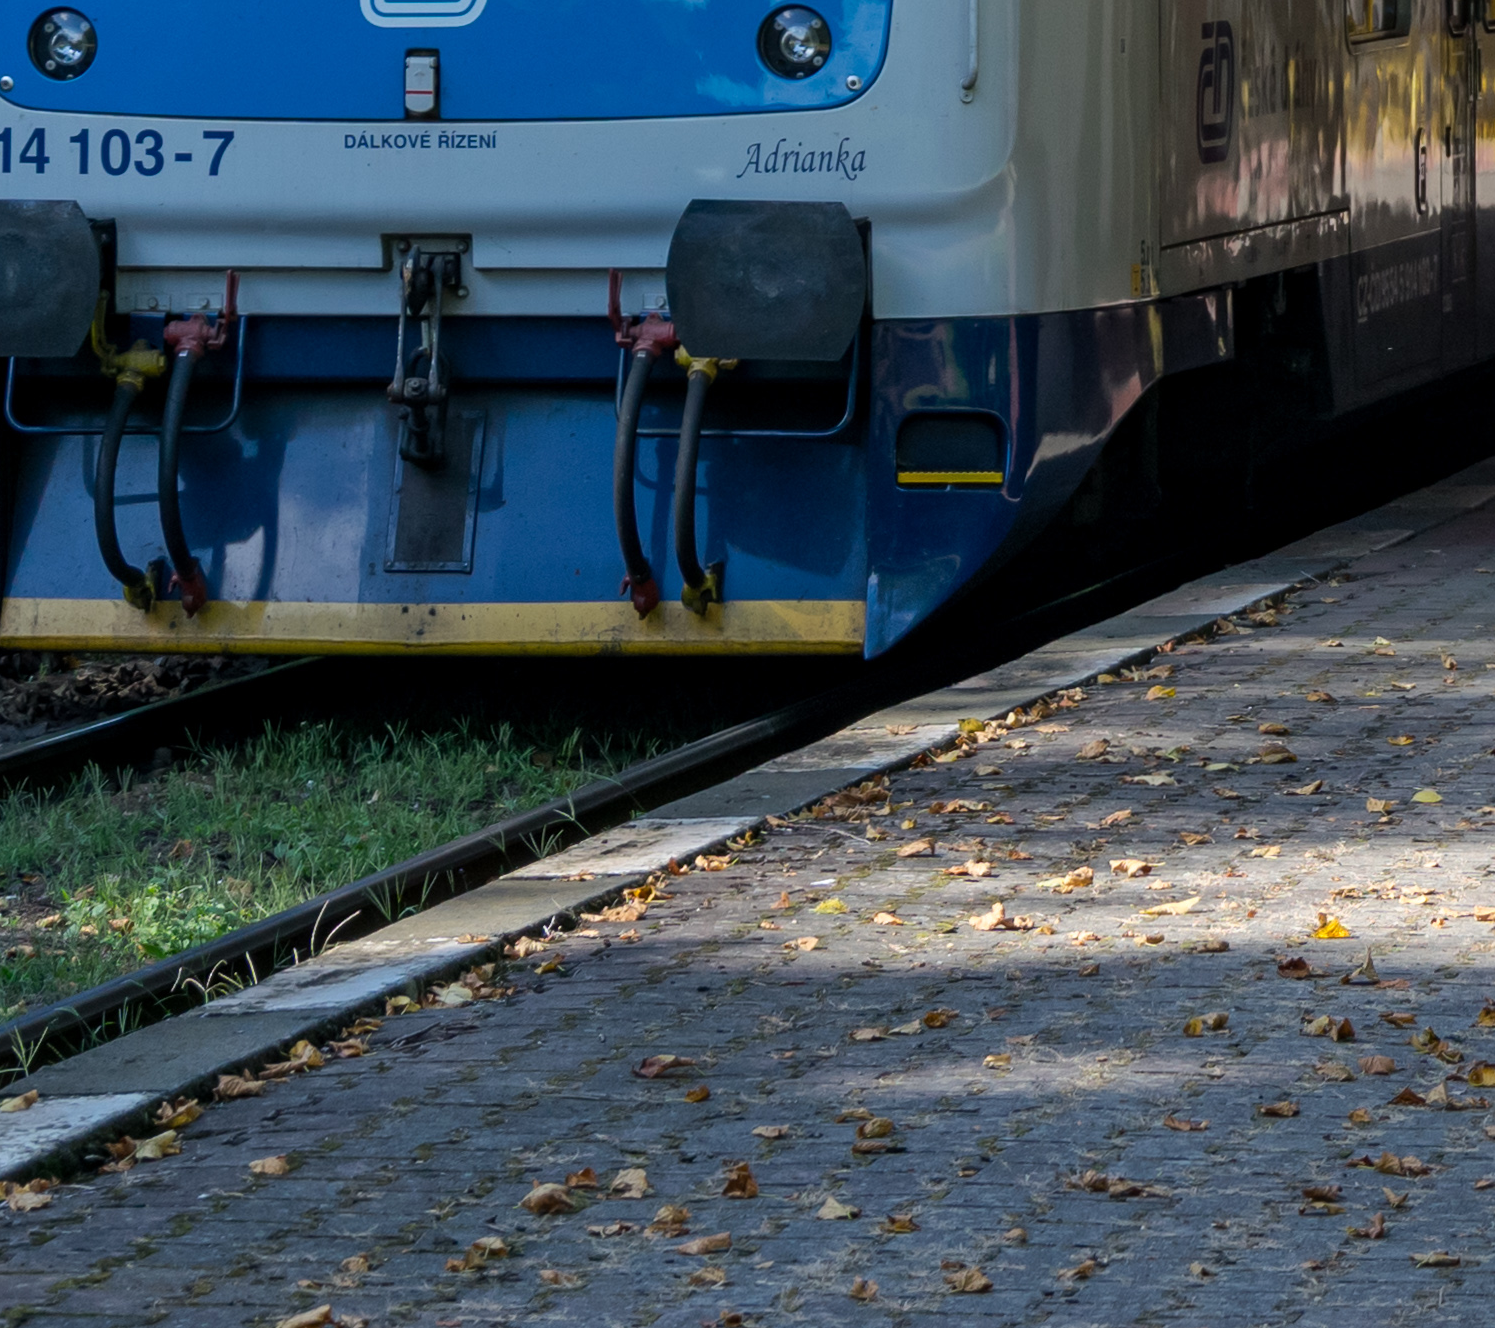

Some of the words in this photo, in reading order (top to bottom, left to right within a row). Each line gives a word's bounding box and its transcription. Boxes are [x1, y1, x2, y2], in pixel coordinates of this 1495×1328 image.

[69, 127, 235, 177] 103-7
[343, 130, 431, 149] DÁLKOVÉ
[437, 130, 499, 149] ŘÍZENÍ
[736, 137, 867, 181] Adrianka
